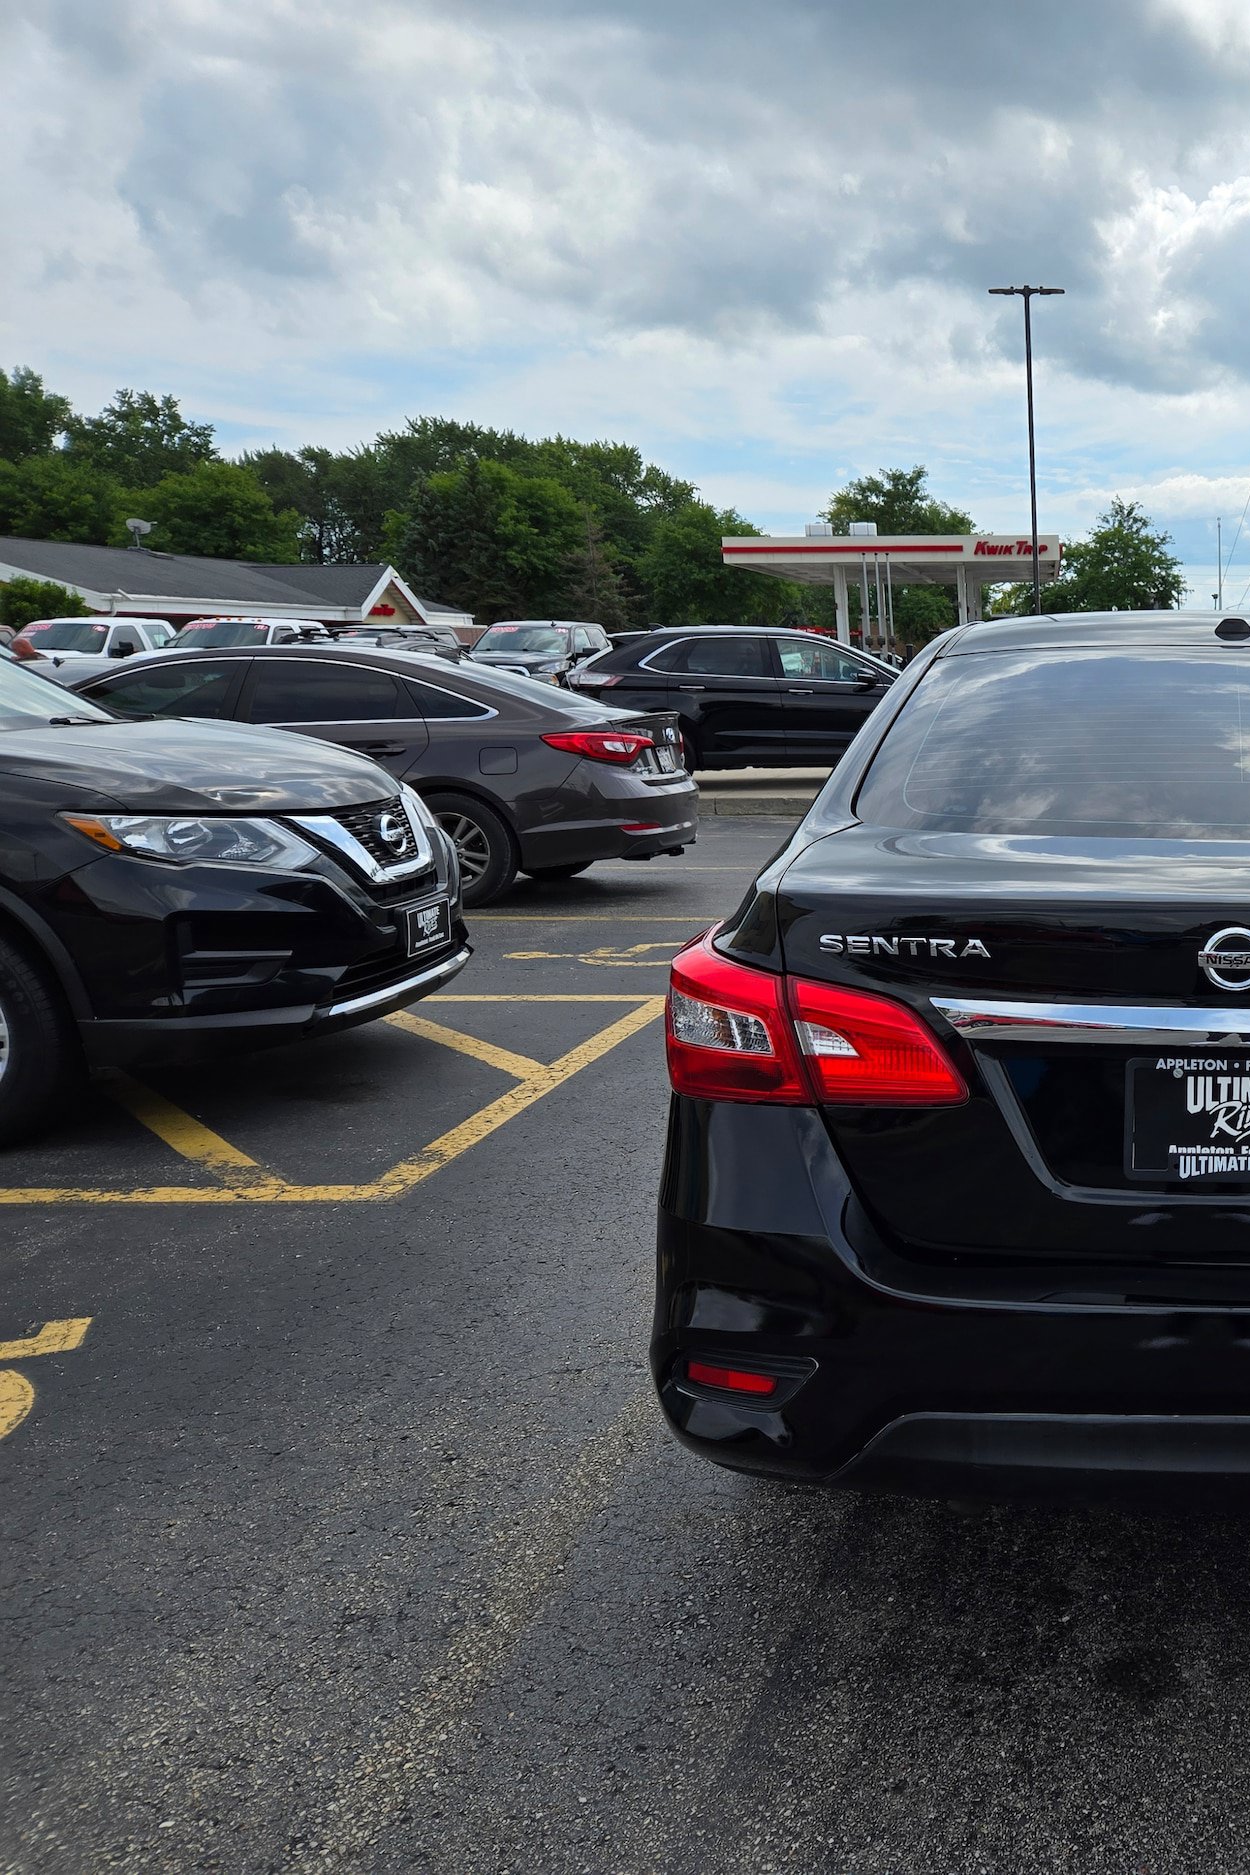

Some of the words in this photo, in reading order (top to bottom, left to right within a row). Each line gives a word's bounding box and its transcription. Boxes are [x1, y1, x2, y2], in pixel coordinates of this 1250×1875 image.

[974, 541, 1015, 555] KWIK
[1016, 541, 1048, 555] TRP
[819, 934, 991, 958] SENTRA
[1156, 1058, 1228, 1071] APPLETON
